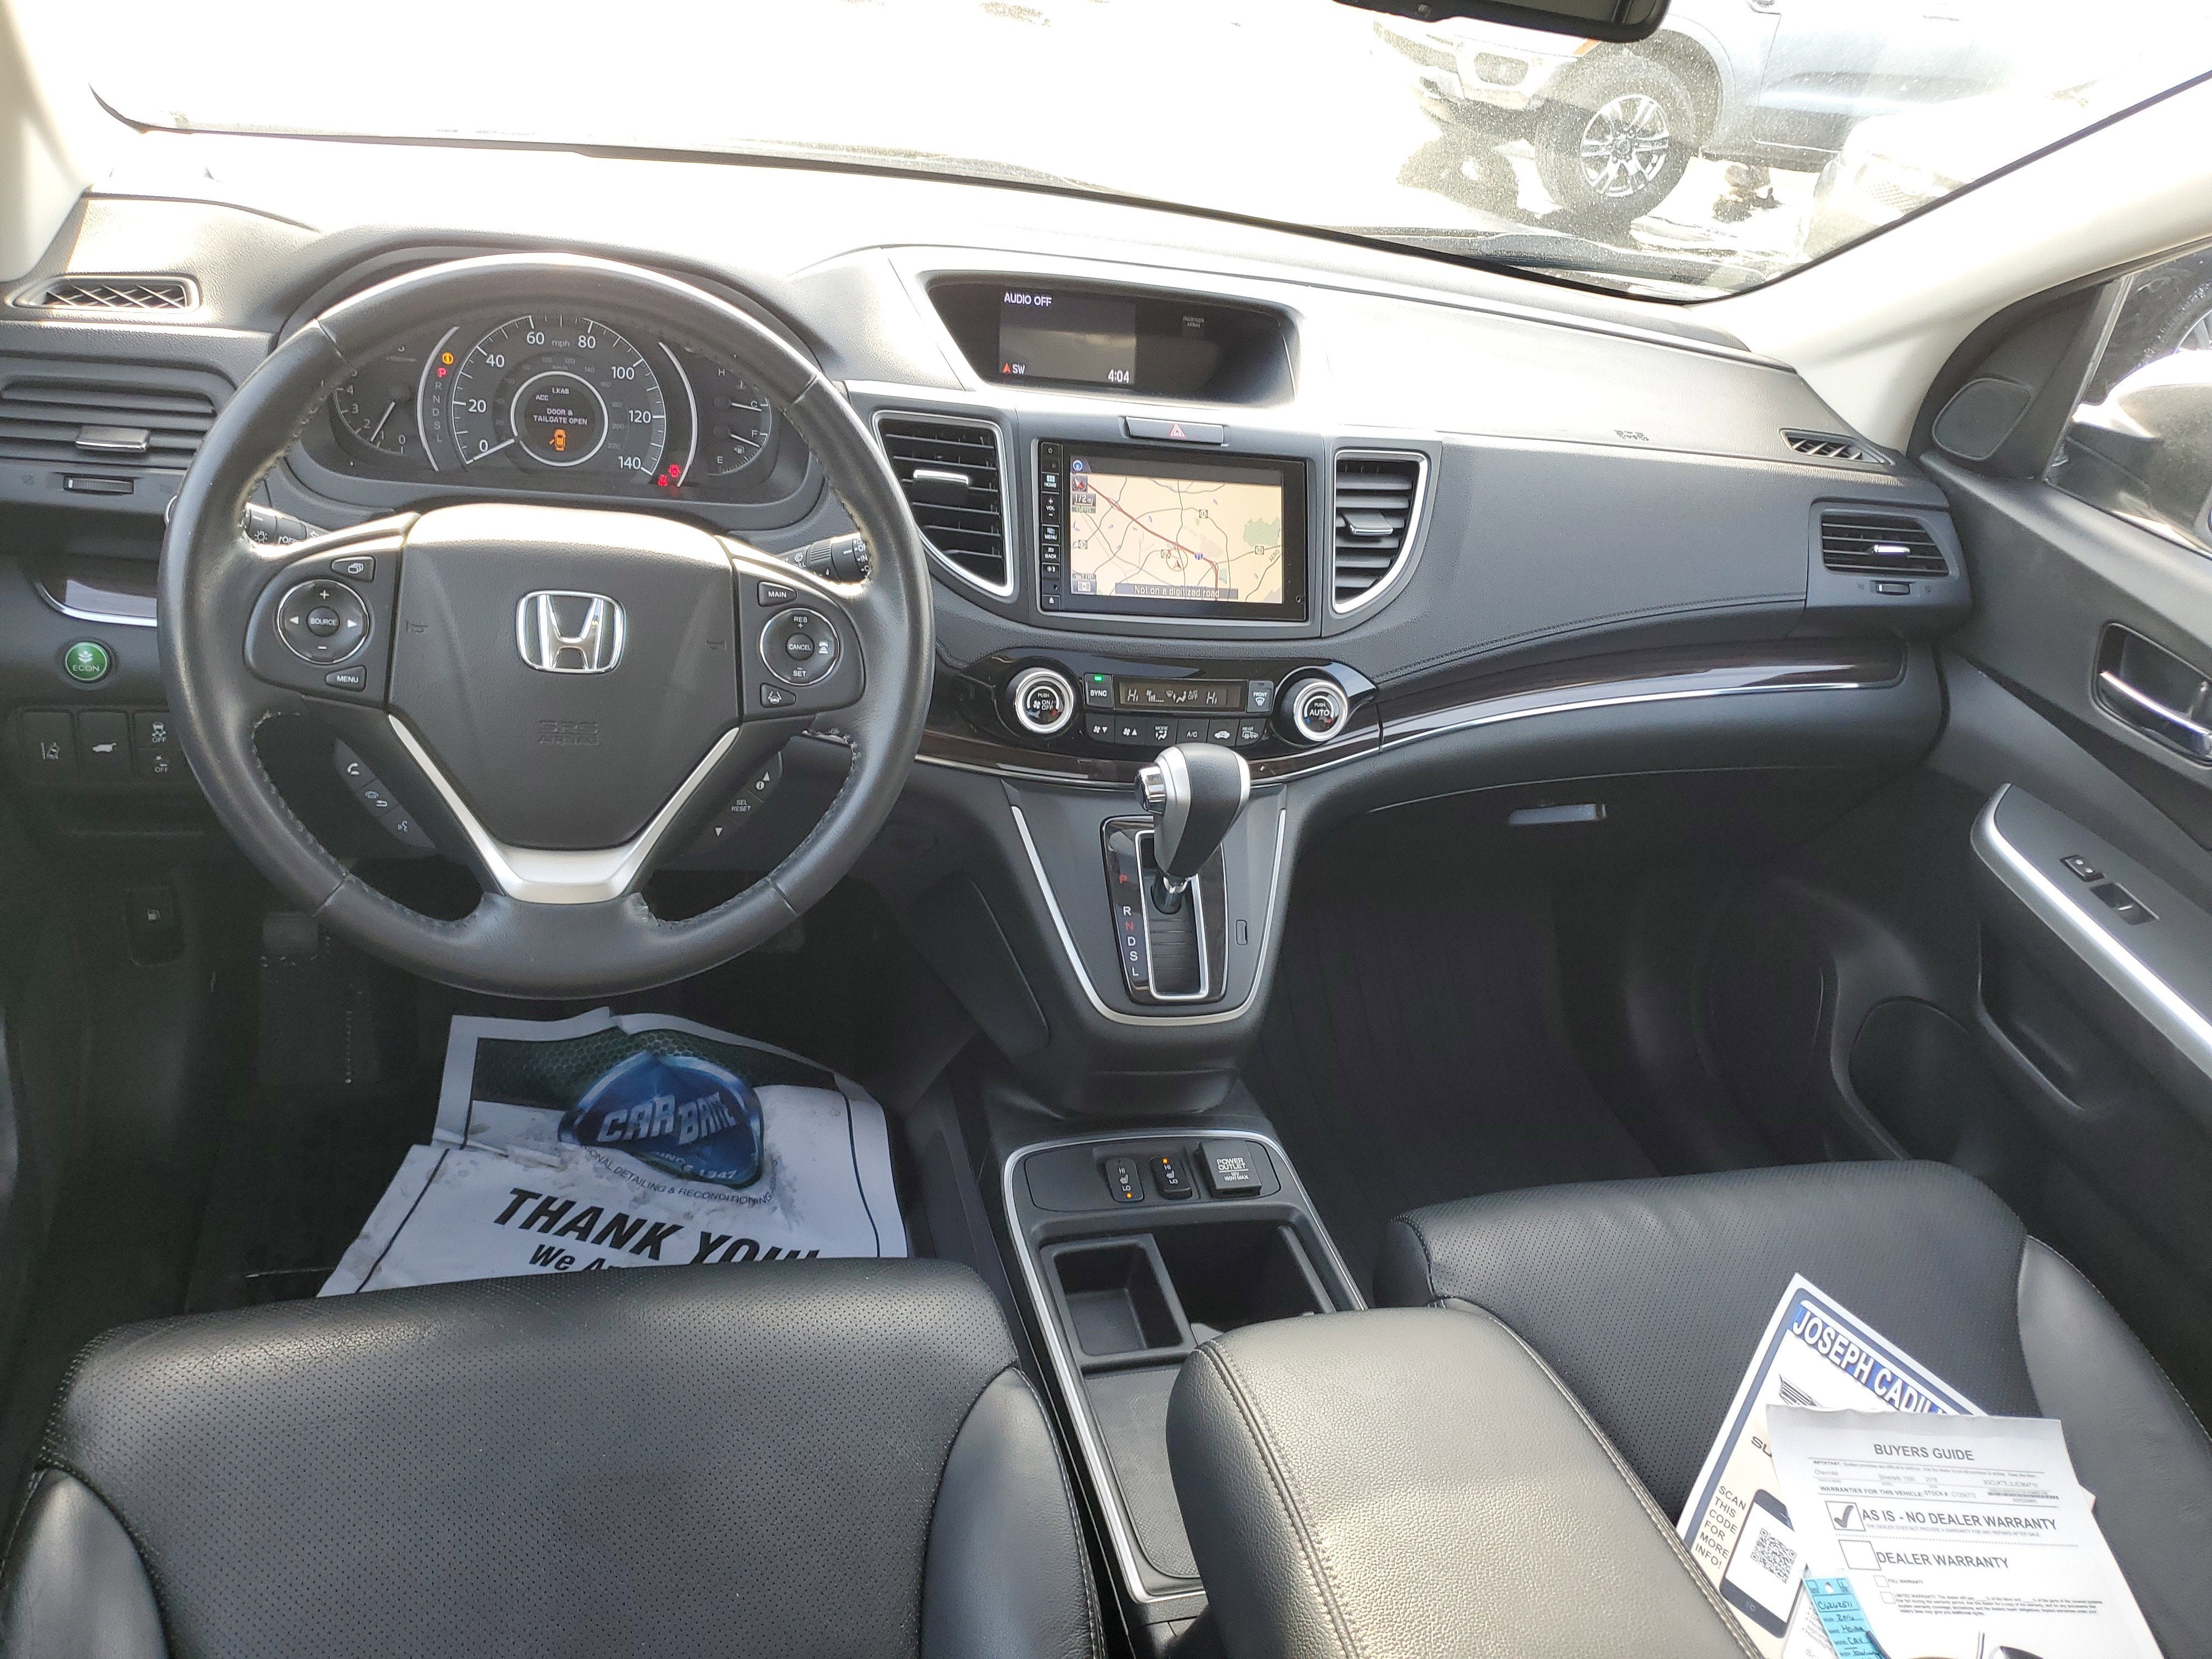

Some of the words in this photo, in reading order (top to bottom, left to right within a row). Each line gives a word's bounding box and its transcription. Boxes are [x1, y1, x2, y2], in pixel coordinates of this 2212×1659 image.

[1004, 292, 1032, 305] AUDIO
[1034, 296, 1052, 307] OFF
[527, 331, 545, 345] 60
[552, 340, 570, 348] mph
[578, 335, 596, 349] 80
[486, 354, 505, 368] 40
[437, 368, 447, 377] P
[611, 366, 635, 380] 100
[719, 368, 725, 376] H
[1012, 364, 1025, 375] SW
[1108, 369, 1130, 383] 4:04
[347, 385, 353, 395] 4
[433, 395, 440, 403] N
[352, 404, 358, 414] 3
[433, 408, 439, 416] D
[469, 399, 487, 413] 20
[364, 419, 370, 428] 2
[533, 415, 567, 424] TAILGATE
[629, 410, 651, 424] 120
[435, 421, 440, 430] S
[399, 435, 406, 444] 0
[479, 439, 488, 452] 0
[618, 456, 641, 470] 140
[717, 456, 724, 464] E
[1075, 494, 1087, 503] 1/2
[1135, 585, 1148, 594] Not
[1169, 588, 1200, 597] digitized
[1203, 589, 1220, 597] road
[311, 617, 336, 627] SOURCE
[337, 675, 359, 684] MENU
[1119, 875, 1127, 884] P
[1123, 906, 1132, 916] R
[1127, 936, 1136, 946] D
[1129, 951, 1138, 961] S
[1132, 967, 1139, 977] L
[597, 1094, 675, 1143] CAR
[1218, 1163, 1246, 1171] OUTLET
[613, 1166, 667, 1192] DETAILING
[494, 1188, 685, 1261] THANK
[529, 1244, 575, 1271] We
[1792, 1311, 1875, 1386] JOSEPH
[1874, 1444, 1929, 1458] BUYERS
[1933, 1448, 1974, 1460] GUIDE
[1719, 1486, 1746, 1510] SCAN
[1716, 1496, 1736, 1517] THIS
[1709, 1509, 1738, 1534] CODE
[1863, 1510, 1879, 1521] AS
[1882, 1510, 1895, 1521] IS
[1906, 1511, 1926, 1523] NO
[1928, 1513, 1982, 1527] DEALER
[1983, 1516, 2056, 1530] WARRANTY
[1705, 1521, 1725, 1541] FOR
[1700, 1532, 1730, 1559] MORE
[1696, 1543, 1722, 1569] INFO!
[1876, 1552, 1932, 1565] DEALER
[1933, 1554, 2008, 1568] WARRANTY
